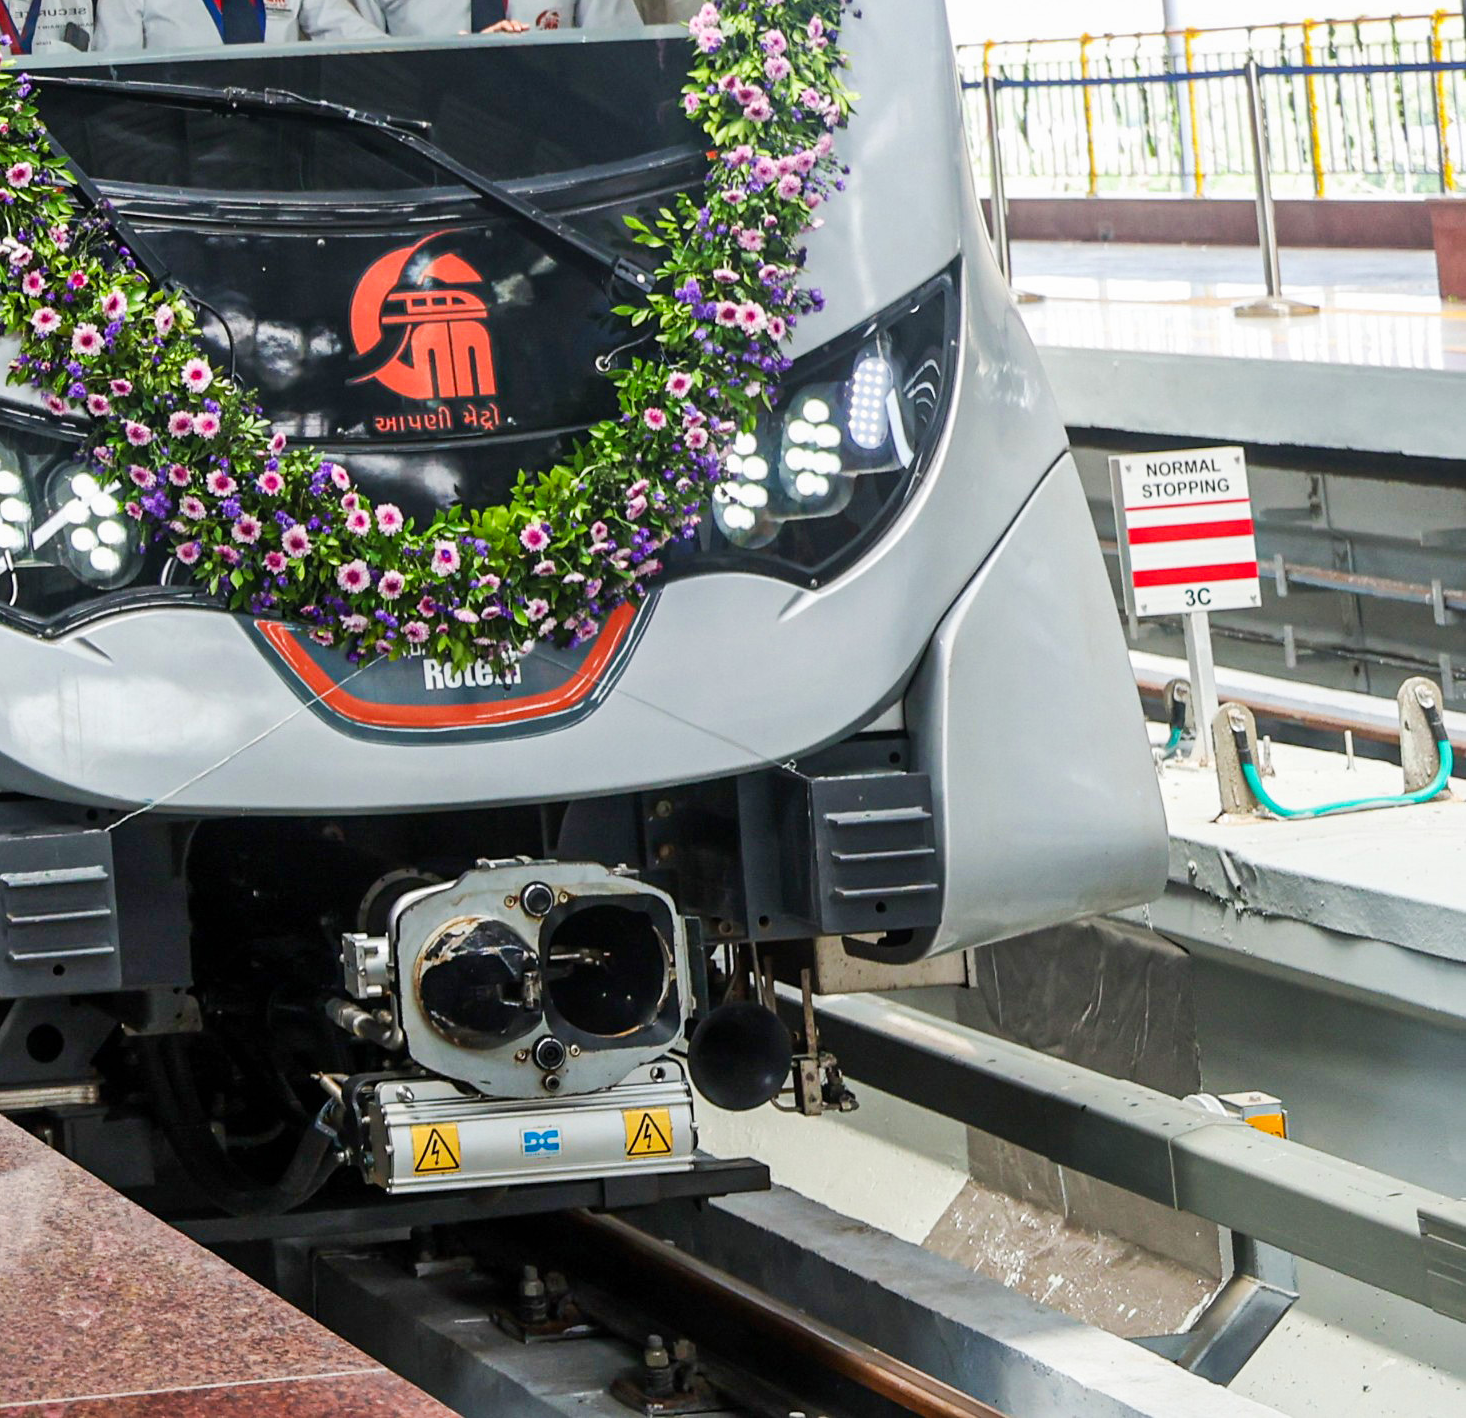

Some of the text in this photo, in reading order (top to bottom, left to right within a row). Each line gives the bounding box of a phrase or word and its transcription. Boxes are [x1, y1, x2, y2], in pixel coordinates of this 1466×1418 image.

[375, 403, 501, 433] આપણી મેટ્રો
[1146, 458, 1221, 477] NORMAL
[1142, 478, 1230, 499] STOPPING
[1184, 588, 1212, 607] 3C
